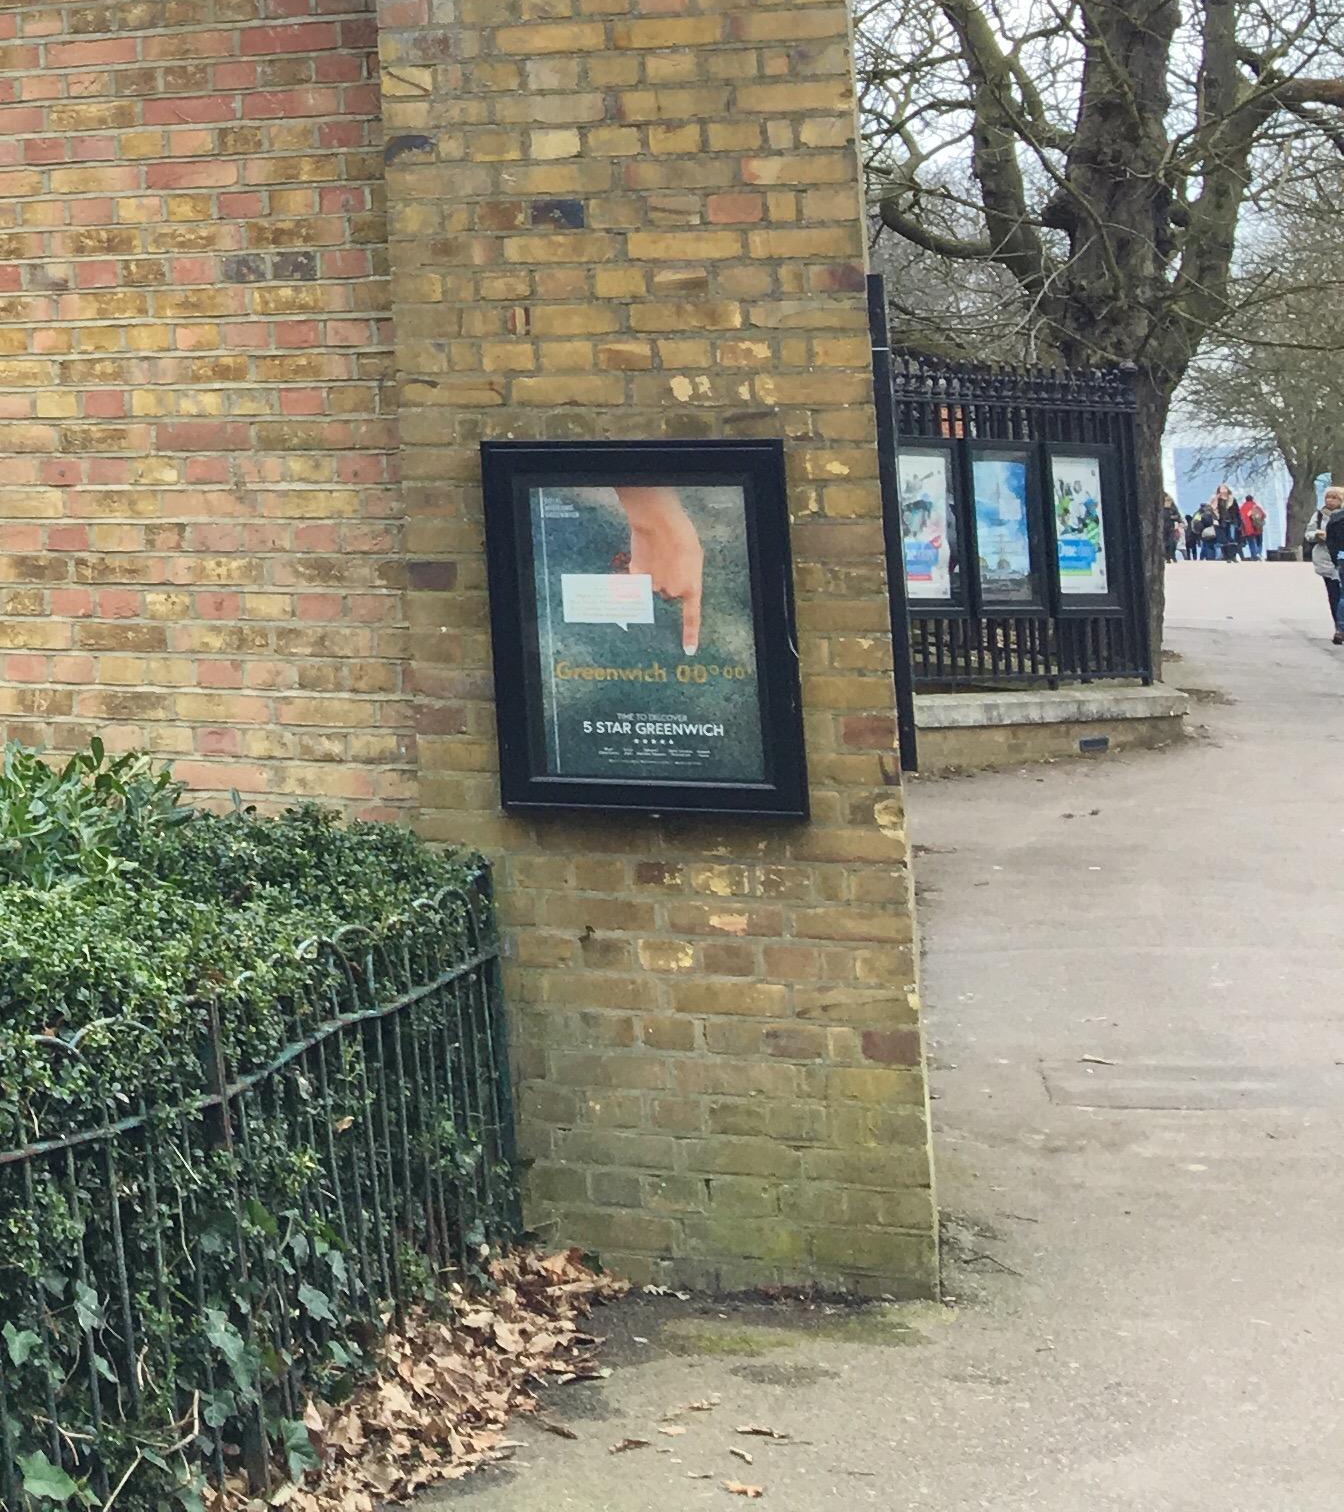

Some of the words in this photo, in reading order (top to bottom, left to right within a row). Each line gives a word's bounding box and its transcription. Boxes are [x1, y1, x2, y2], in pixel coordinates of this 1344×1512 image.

[555, 660, 667, 682] Greenwich
[583, 720, 593, 734] 5
[596, 721, 632, 735] STAR
[635, 722, 724, 737] GREENWICH
